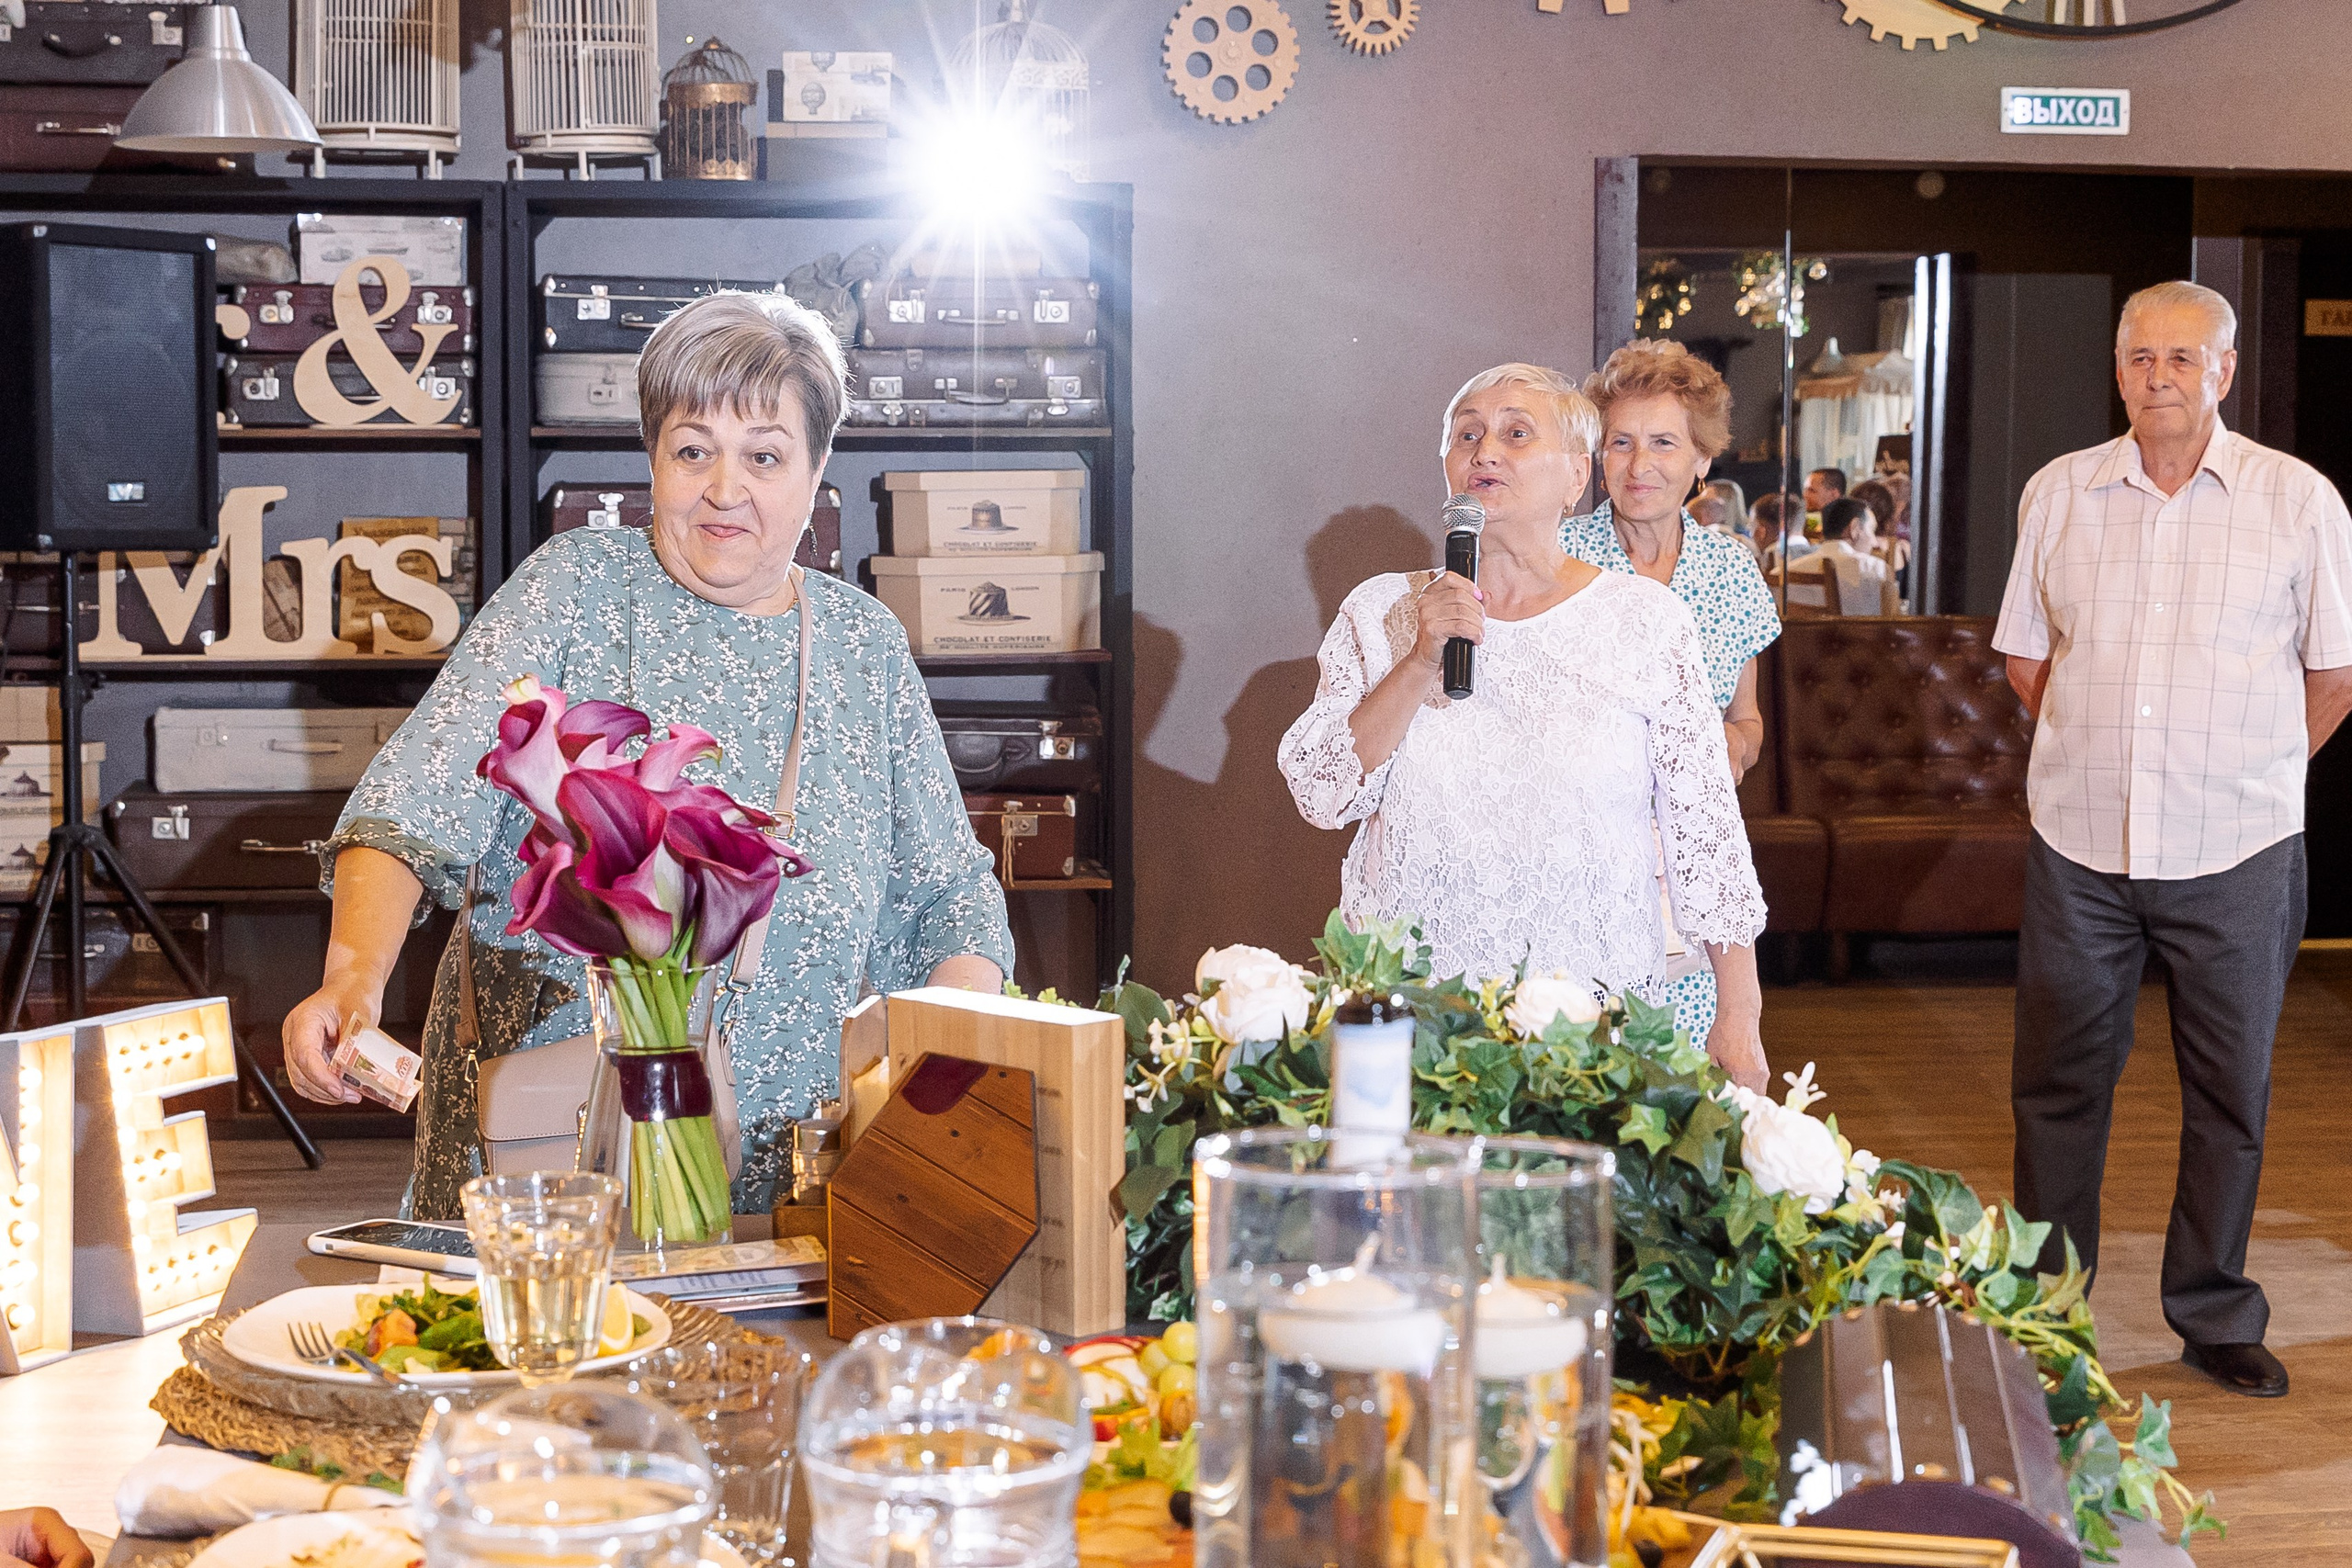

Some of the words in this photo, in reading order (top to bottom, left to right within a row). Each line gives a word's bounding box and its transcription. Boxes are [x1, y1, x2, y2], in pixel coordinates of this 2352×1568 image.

[2013, 96, 2115, 127] ВЫХОД
[293, 255, 462, 428] &
[78, 486, 460, 657] Mrs
